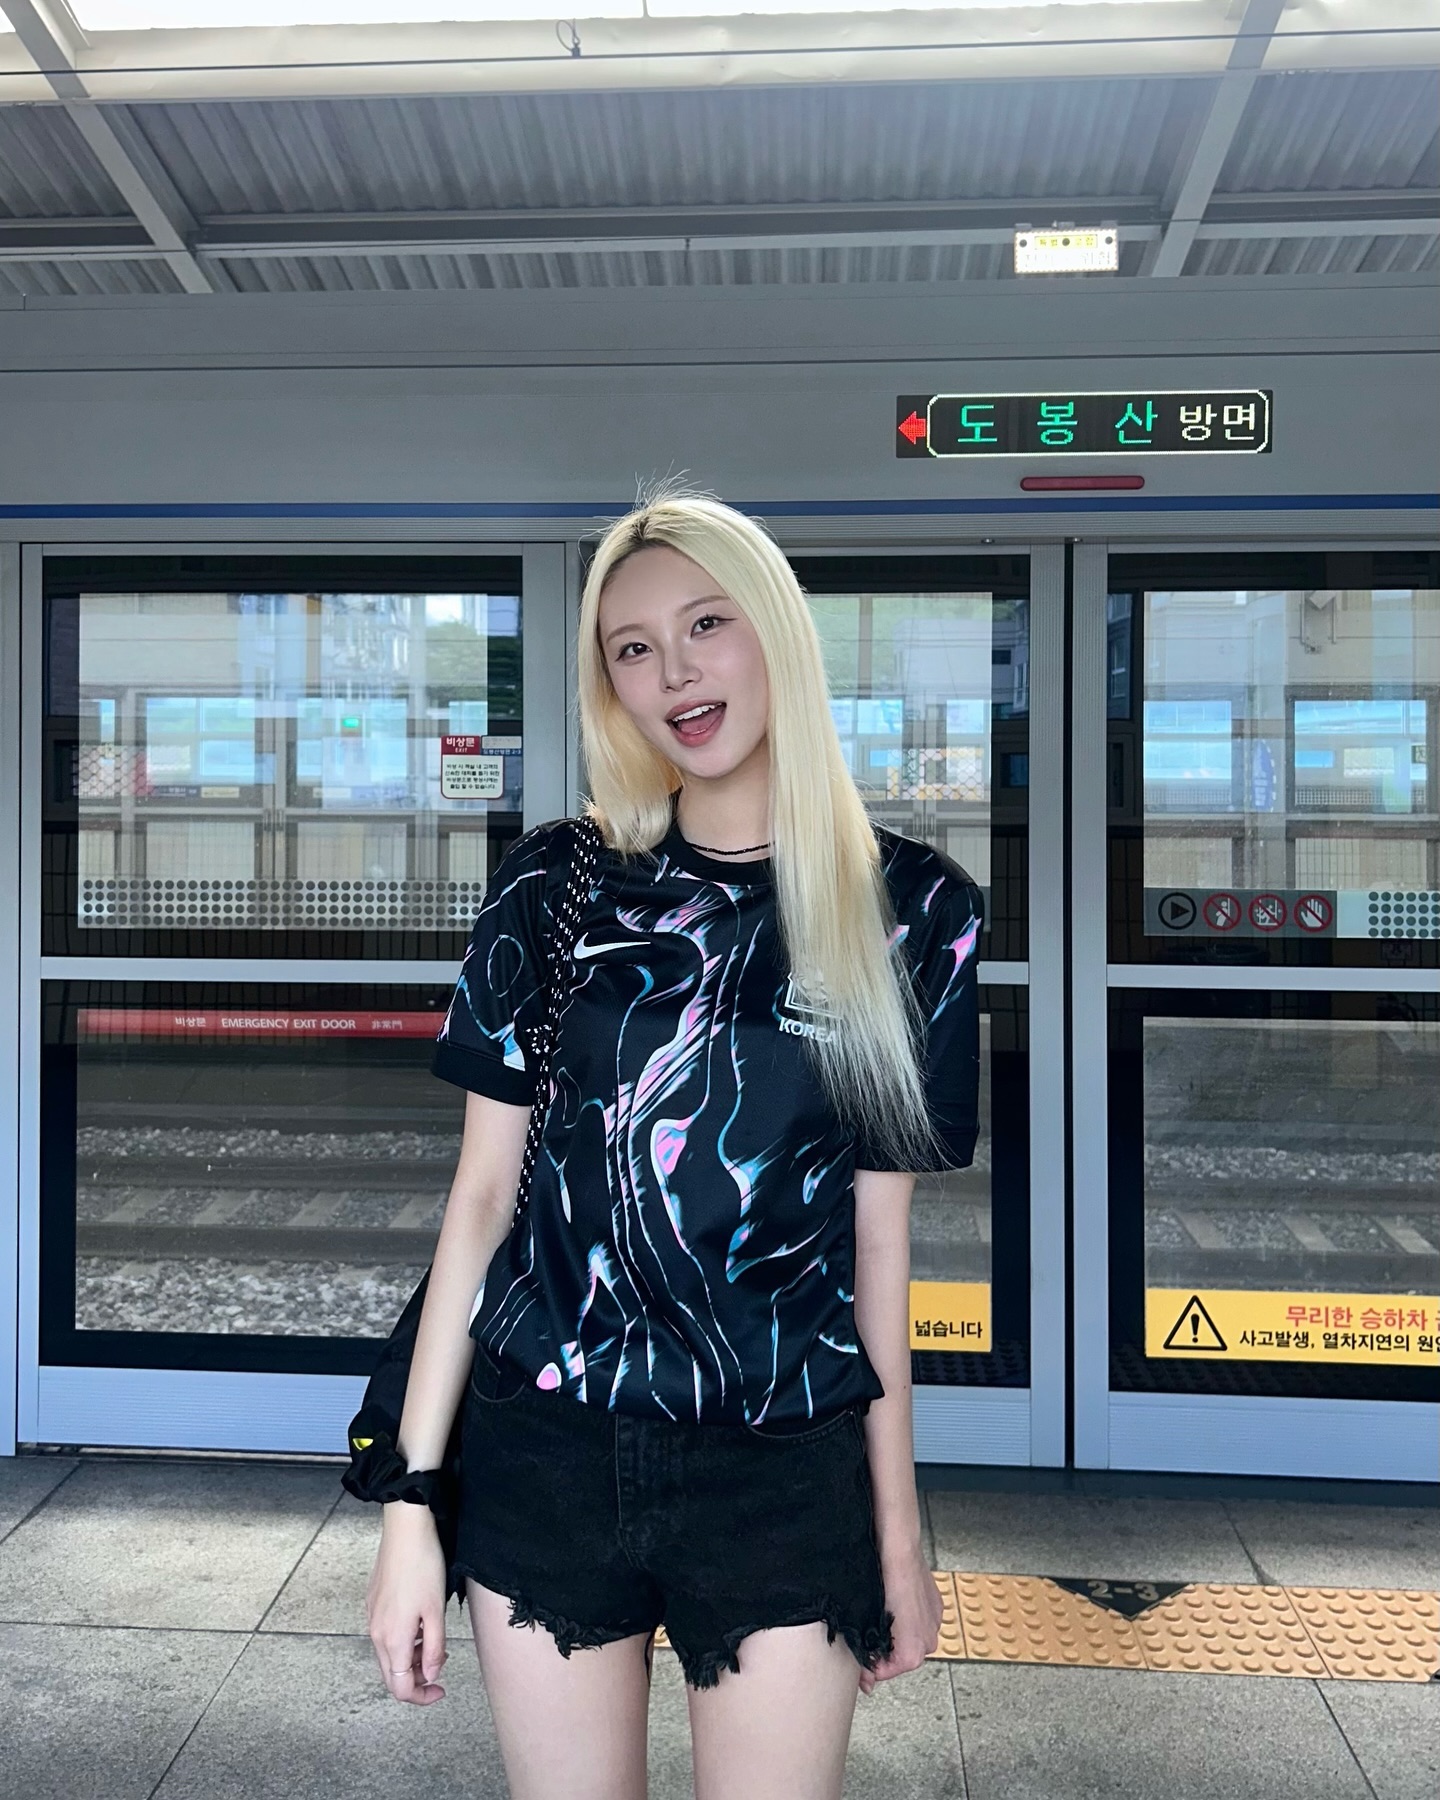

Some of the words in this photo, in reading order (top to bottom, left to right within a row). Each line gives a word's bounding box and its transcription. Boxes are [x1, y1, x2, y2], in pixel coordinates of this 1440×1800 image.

[1179, 403, 1255, 441] 방면
[446, 737, 475, 748] 비상문
[175, 1016, 206, 1028] 비상문
[221, 1018, 289, 1029] EMERGENCY
[293, 1019, 317, 1029] EXIT
[321, 1019, 356, 1030] DOOR
[1286, 1305, 1353, 1329] 무리한
[1359, 1307, 1428, 1331] 승하차
[914, 1319, 983, 1339] 넓습니다
[1239, 1330, 1315, 1349] 사고발생,
[1322, 1332, 1410, 1352] 열차지연의
[1087, 1580, 1159, 1601] 2-3
